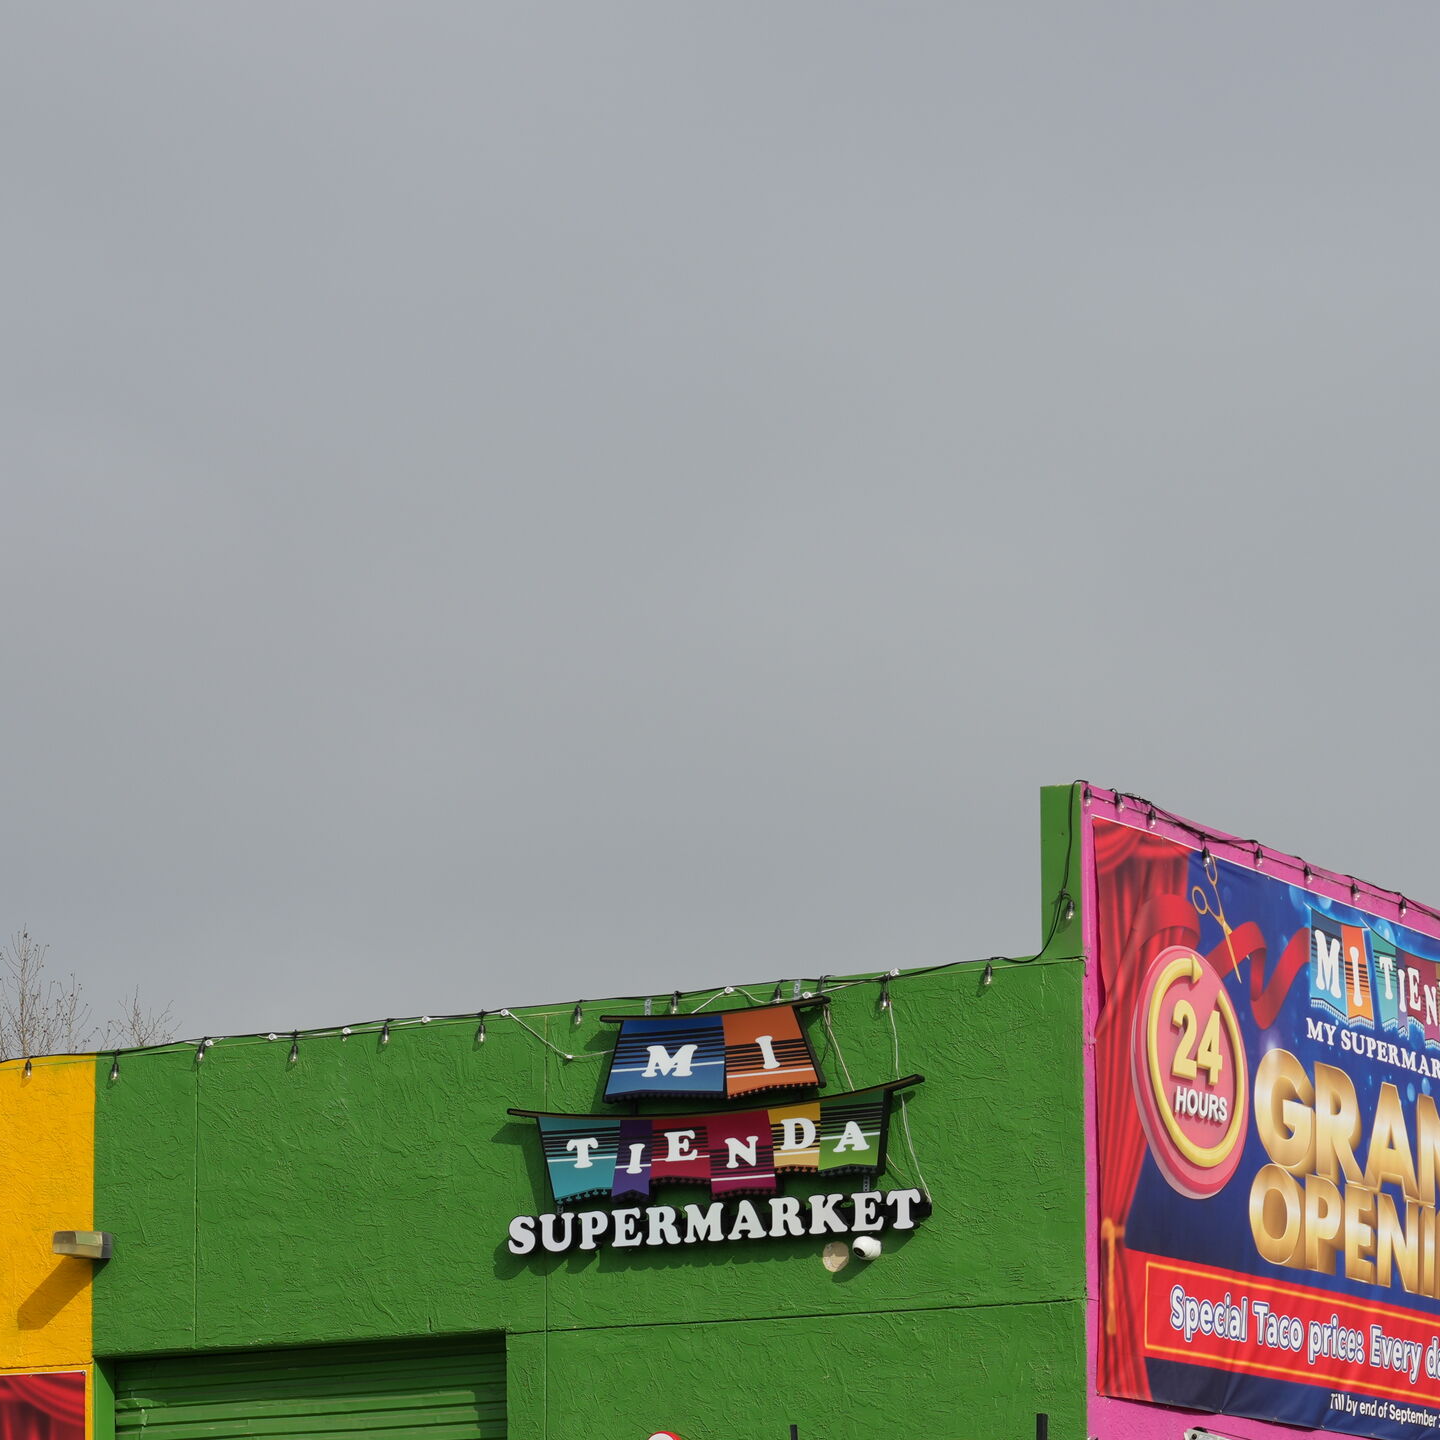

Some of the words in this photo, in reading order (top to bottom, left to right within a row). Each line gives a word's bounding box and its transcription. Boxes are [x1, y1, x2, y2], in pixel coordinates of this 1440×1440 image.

[1315, 929, 1363, 1007] MI
[641, 1035, 781, 1078] MI
[1171, 999, 1223, 1086] 24
[1306, 1017, 1337, 1046] MY
[1175, 1085, 1228, 1123] HOURS
[566, 1116, 871, 1175] TIENDA
[507, 1187, 921, 1256] SUPERMARKET
[1169, 1284, 1249, 1343] Special
[1252, 1301, 1304, 1352] Taco
[1307, 1314, 1366, 1365] price:
[1369, 1324, 1423, 1384] Every
[1329, 1393, 1345, 1412] Till
[1345, 1394, 1359, 1417] by
[1359, 1398, 1377, 1418] end
[1377, 1400, 1389, 1420] of
[1388, 1403, 1438, 1429] September
